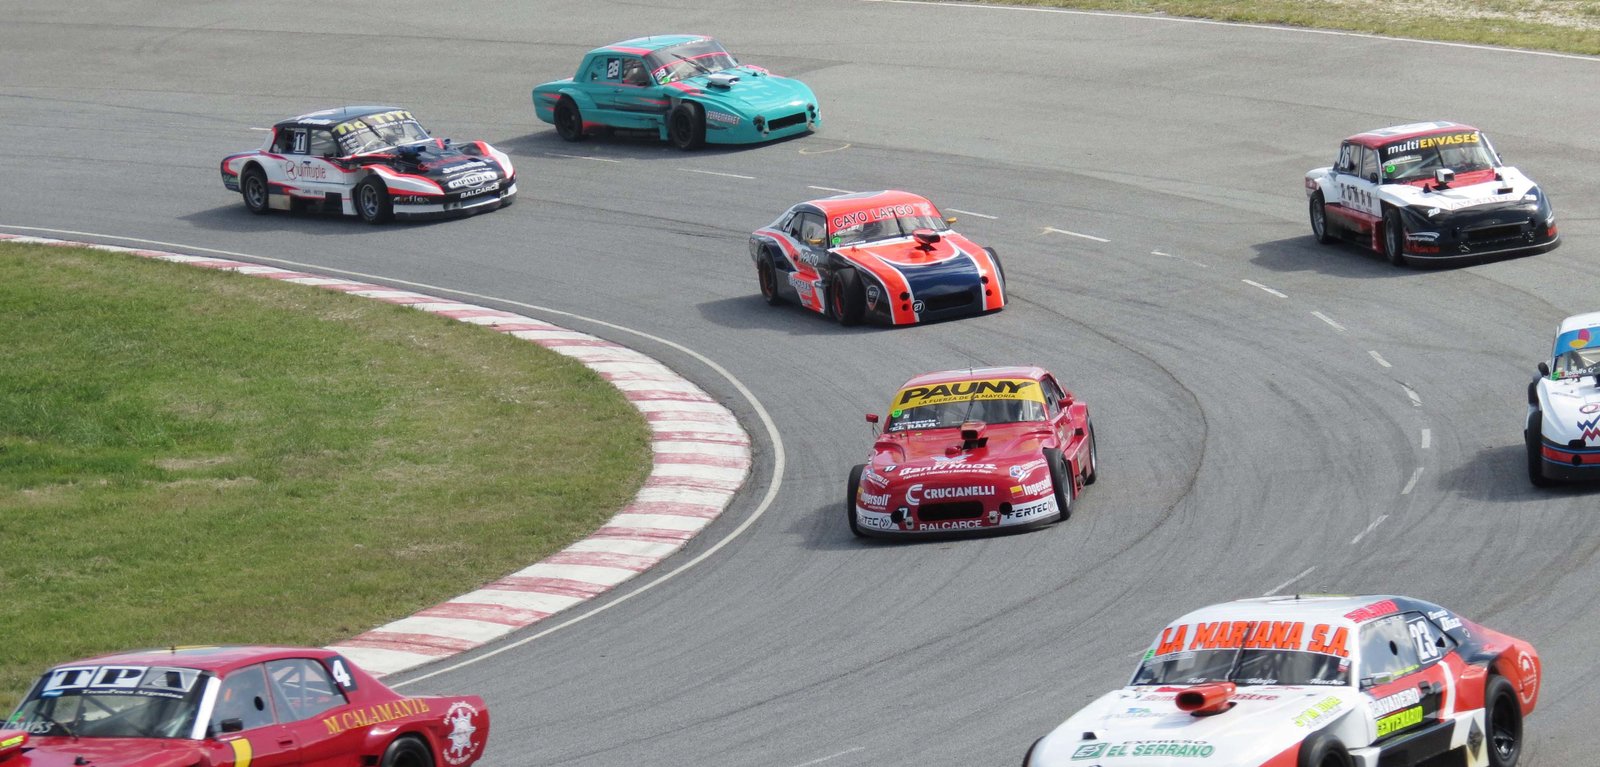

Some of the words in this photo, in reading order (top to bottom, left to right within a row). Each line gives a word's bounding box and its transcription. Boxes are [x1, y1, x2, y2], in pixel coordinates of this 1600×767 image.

[607, 60, 620, 78] 28
[296, 133, 306, 152] 11
[460, 180, 500, 199] BALCARCE
[833, 209, 868, 229] CAYO
[871, 203, 915, 220] LARGO
[912, 302, 924, 312] 27
[899, 381, 1035, 405] PAUNY
[923, 485, 996, 500] CRUCIANELLI
[1006, 502, 1048, 519] FERTEC
[919, 520, 982, 531] BALCARCE
[1155, 624, 1189, 656] LA
[1190, 620, 1305, 650] MARIANA
[1307, 623, 1349, 658] S.A.
[1409, 621, 1439, 661] 23
[49, 666, 197, 690] TPA
[333, 659, 351, 688] 4
[135, 689, 184, 699] Argentina
[1106, 745, 1126, 758] EL
[1132, 744, 1216, 758] SERRANO
